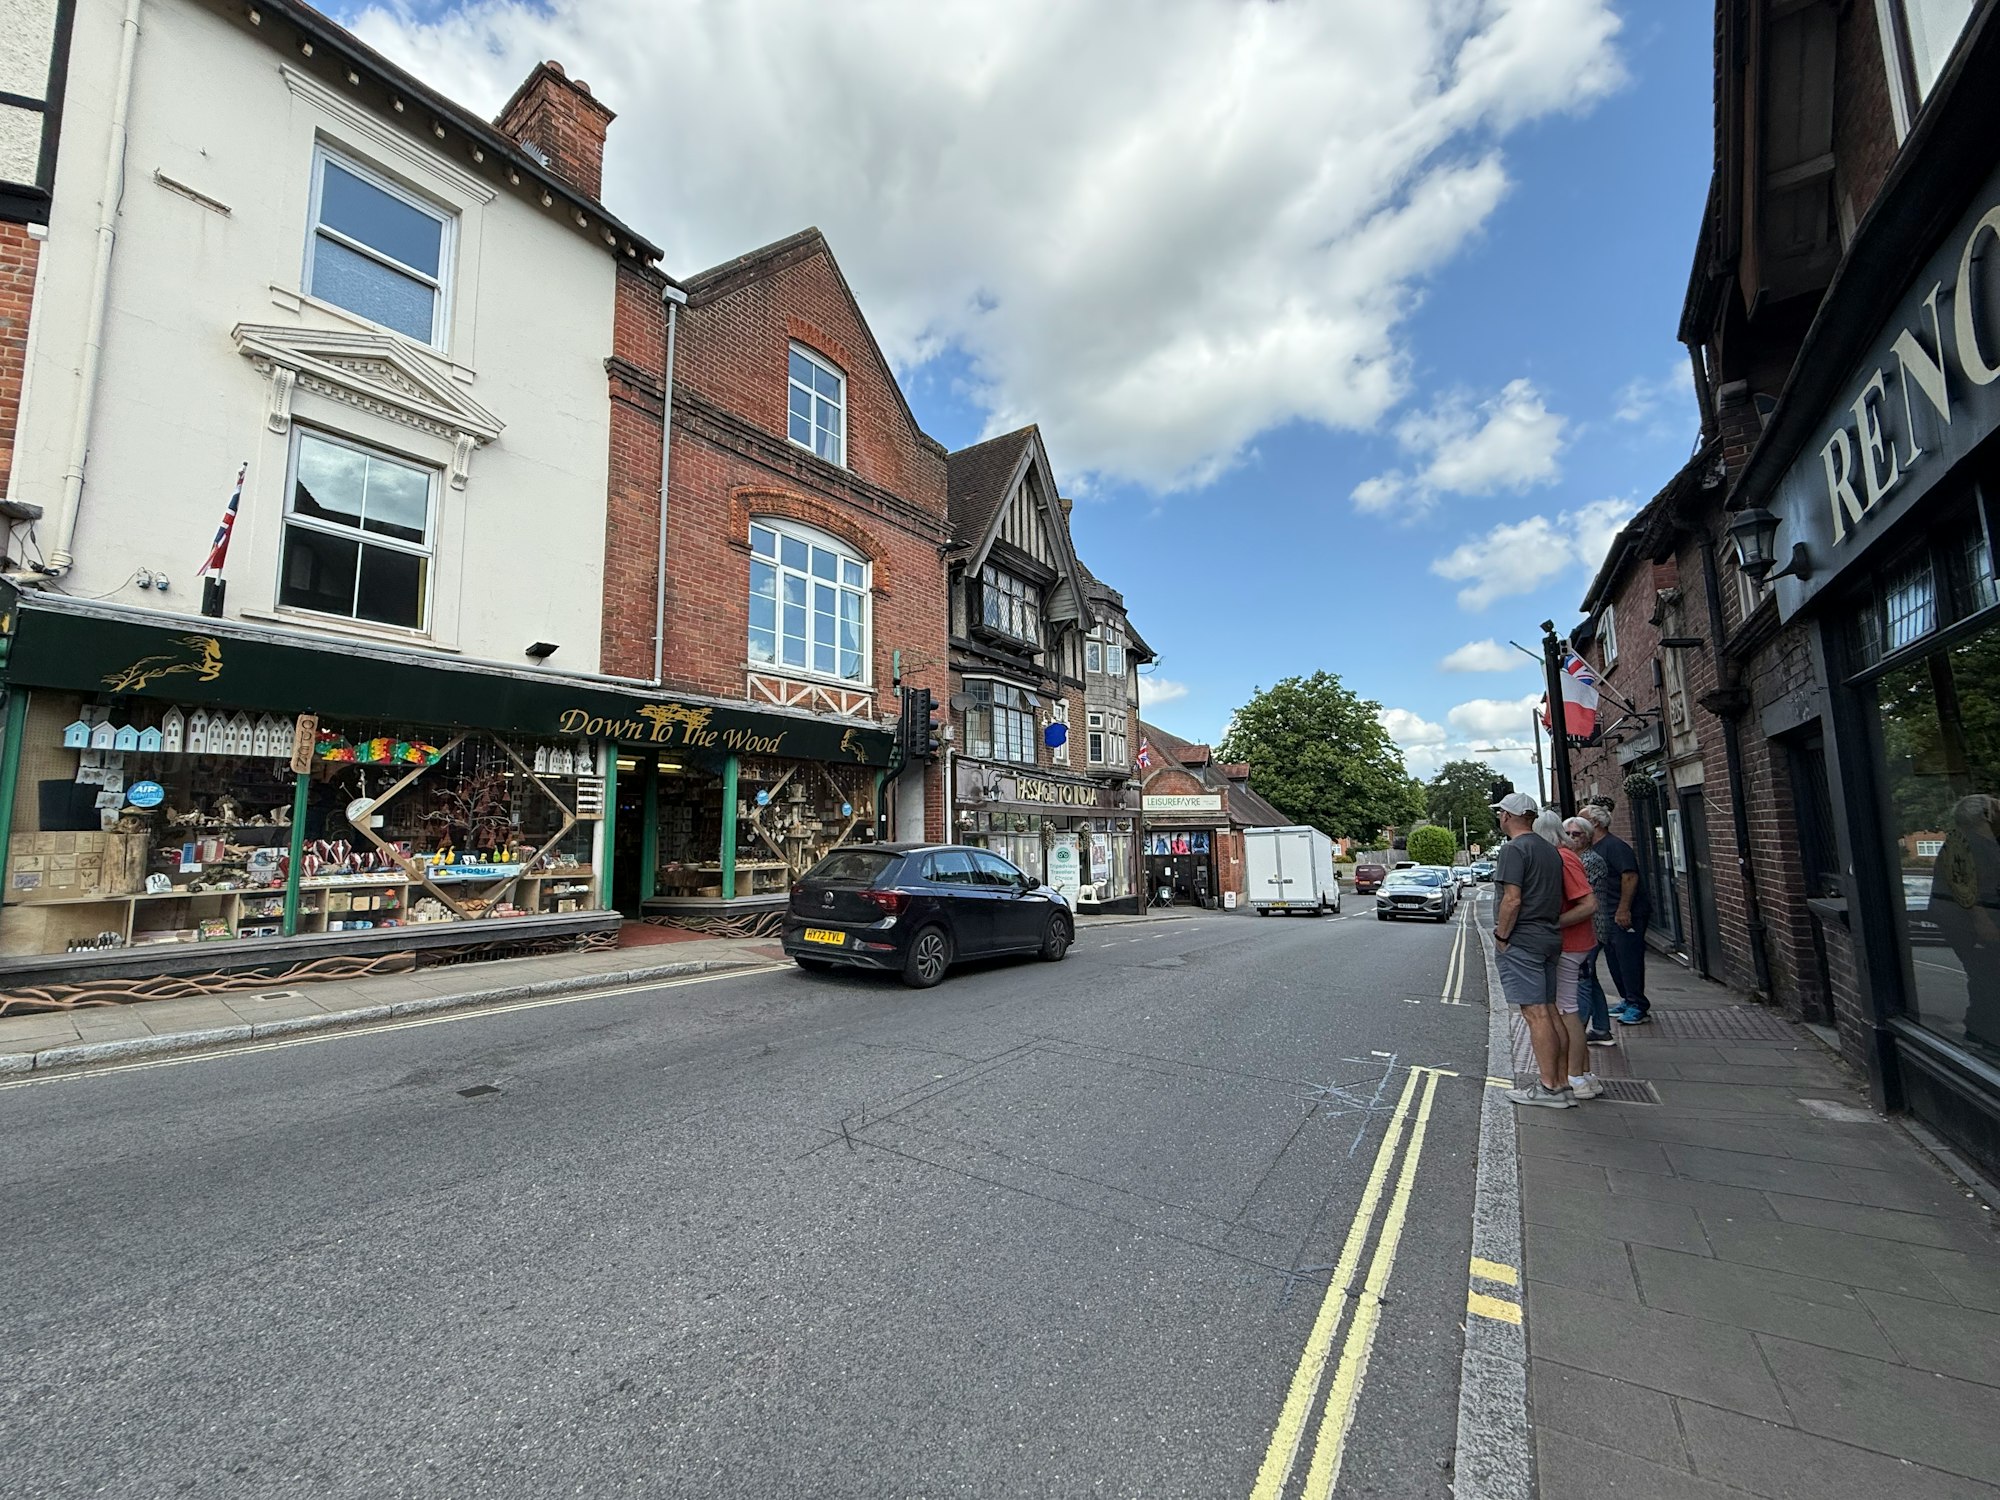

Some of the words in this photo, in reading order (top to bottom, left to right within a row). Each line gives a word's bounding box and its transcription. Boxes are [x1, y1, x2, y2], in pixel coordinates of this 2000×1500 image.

[559, 708, 645, 739] Down
[680, 714, 719, 747] The
[722, 728, 788, 753] Wood
[1016, 778, 1056, 802] PASSAGE
[1056, 783, 1072, 804] TO
[1073, 785, 1099, 806] INDIA
[1147, 797, 1201, 807] LEISUREFAYRE
[807, 929, 825, 940] HY72
[827, 931, 841, 942] TVL
